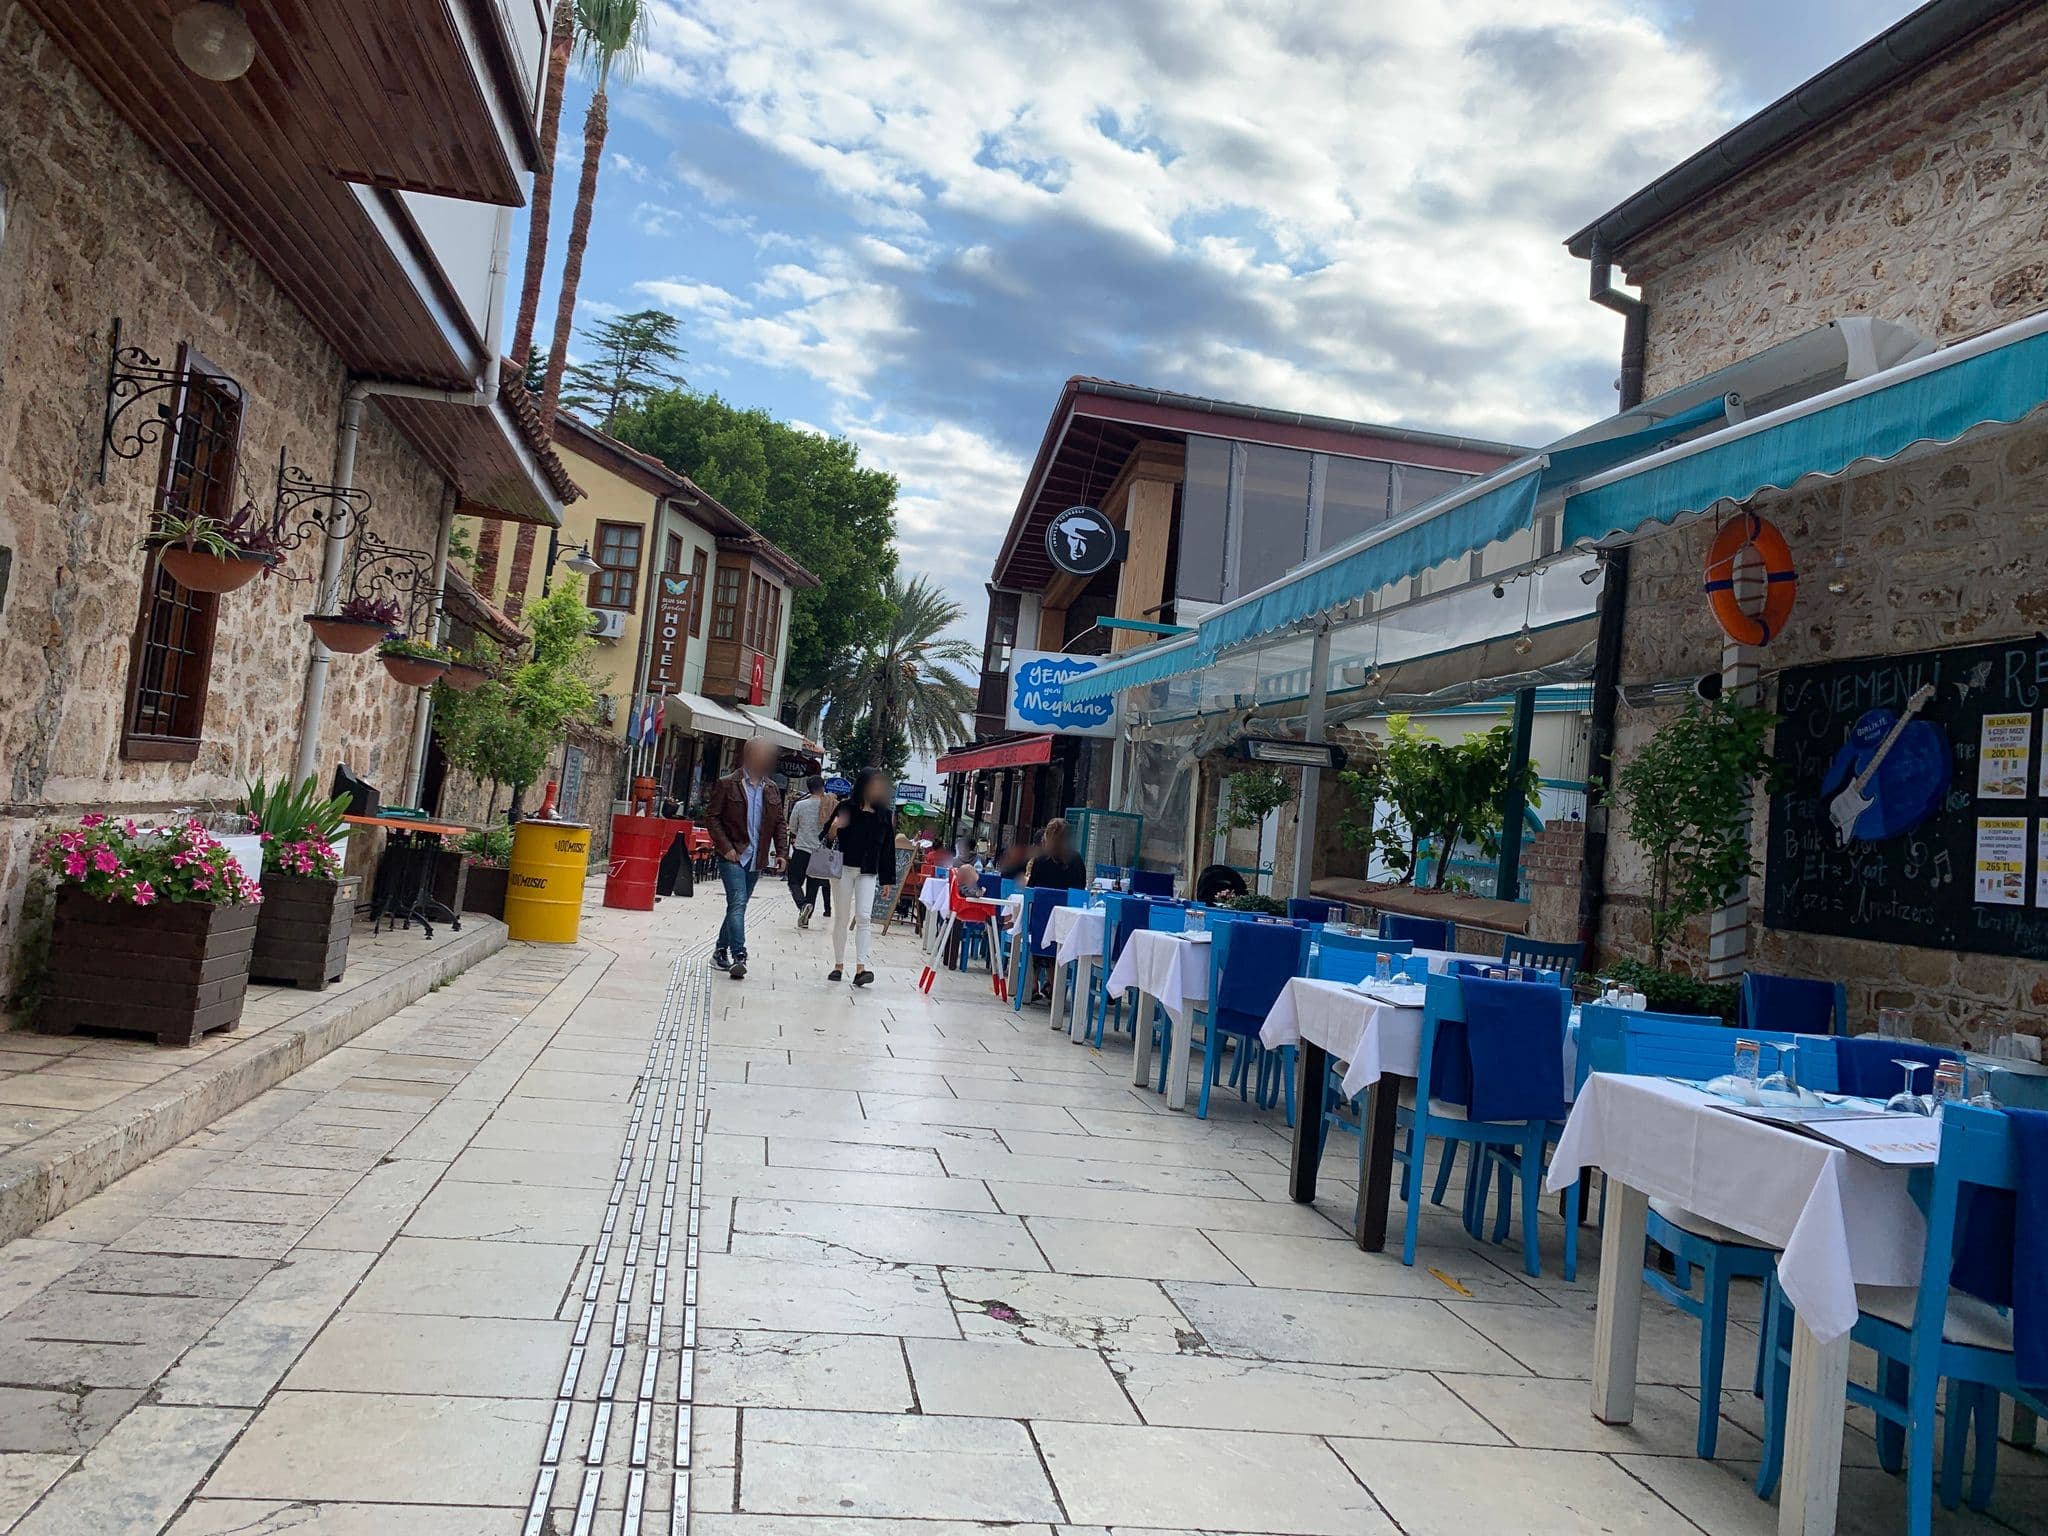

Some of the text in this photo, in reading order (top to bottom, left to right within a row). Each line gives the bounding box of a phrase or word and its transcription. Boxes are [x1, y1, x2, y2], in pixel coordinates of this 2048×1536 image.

[659, 613, 679, 680] HOTEL
[1992, 749, 2006, 758] 200
[1986, 862, 2001, 871] 265
